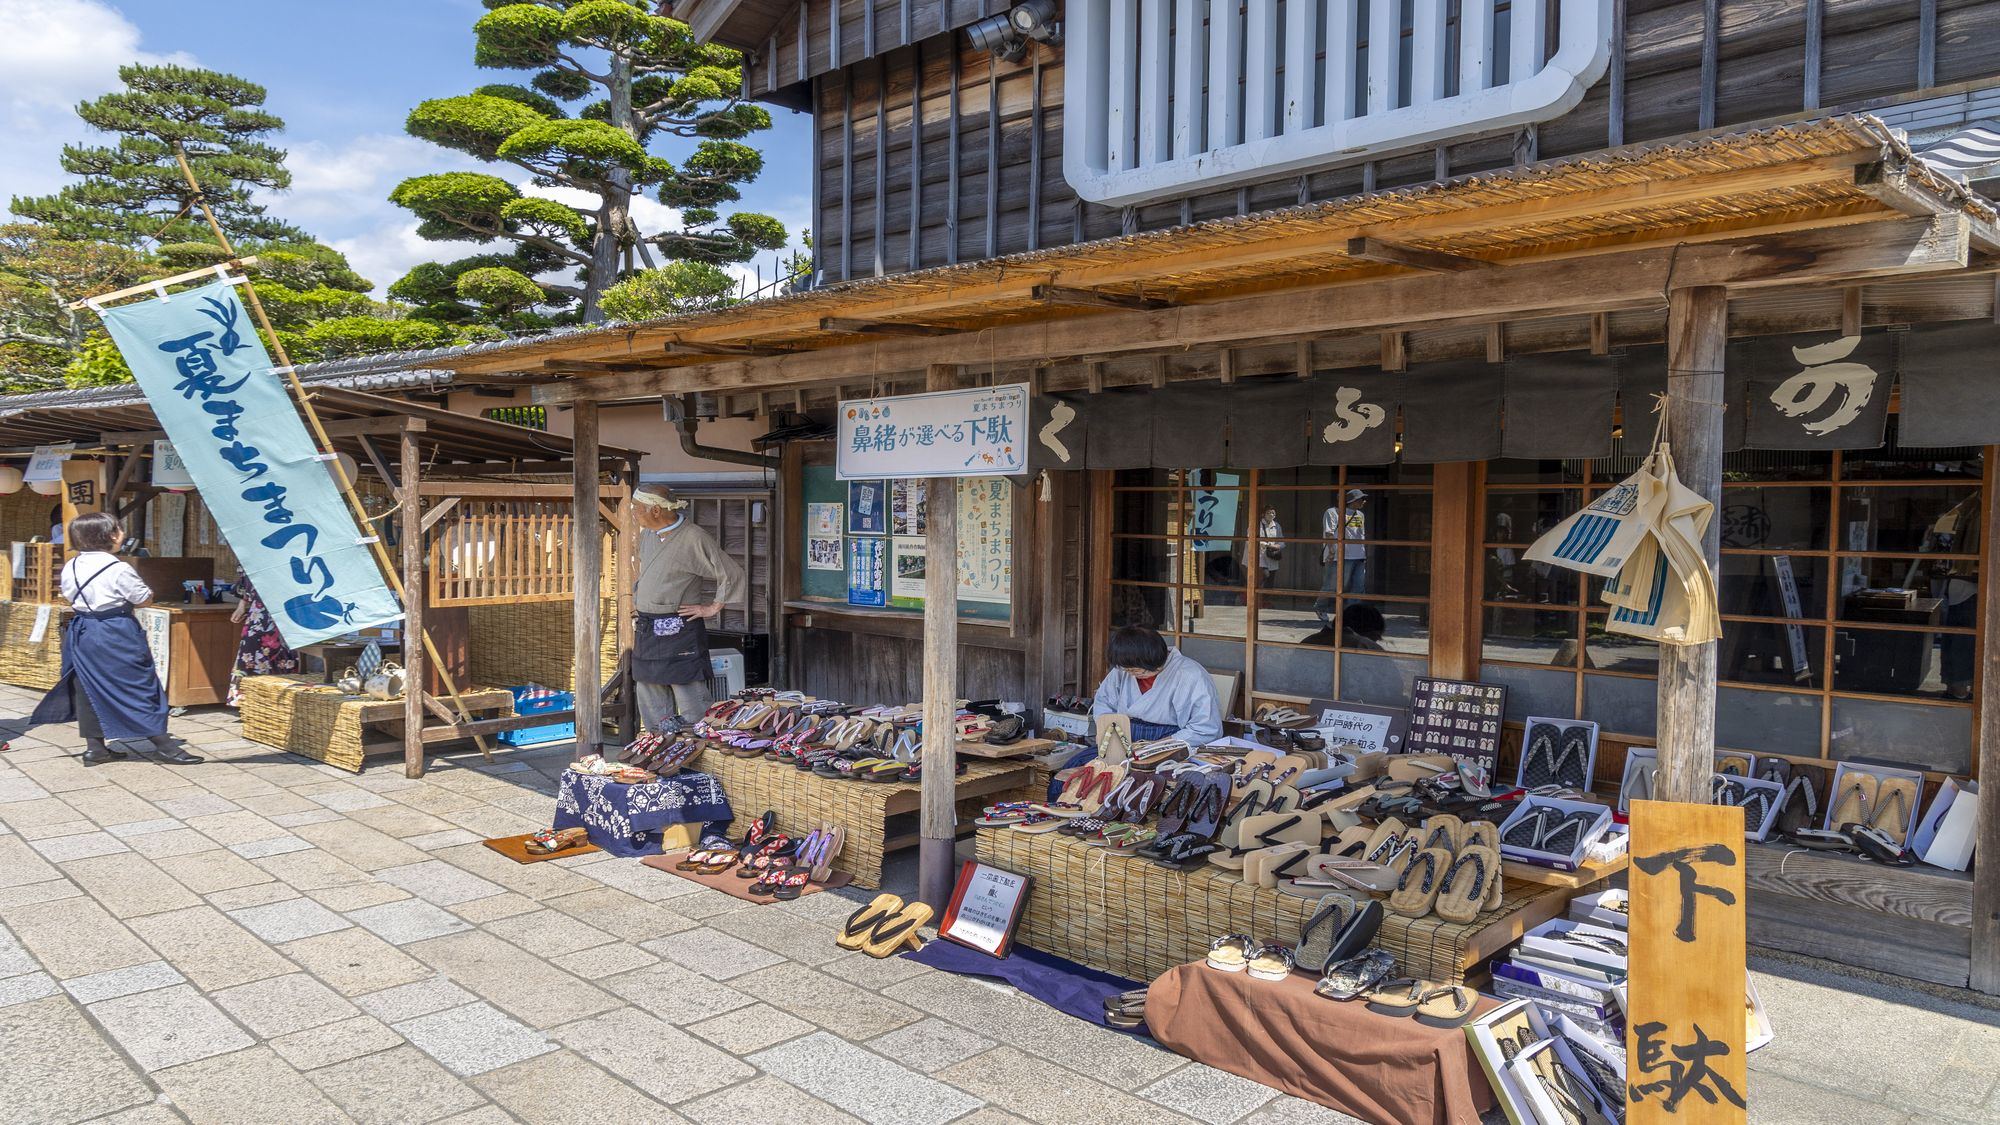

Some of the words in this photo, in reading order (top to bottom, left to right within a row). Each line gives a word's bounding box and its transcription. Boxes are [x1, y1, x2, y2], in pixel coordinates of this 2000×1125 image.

[972, 399, 1022, 412] 夏まちまつり
[850, 414, 1013, 454] 鼻緒が選べる下駄
[1038, 400, 1076, 463] く
[158, 330, 335, 601] 夏まちまつり
[163, 454, 187, 470] 夏の
[988, 479, 1005, 591] 夏まちまつり
[1324, 718, 1373, 732] 江戸時代の
[1629, 843, 1746, 1113] 下駄
